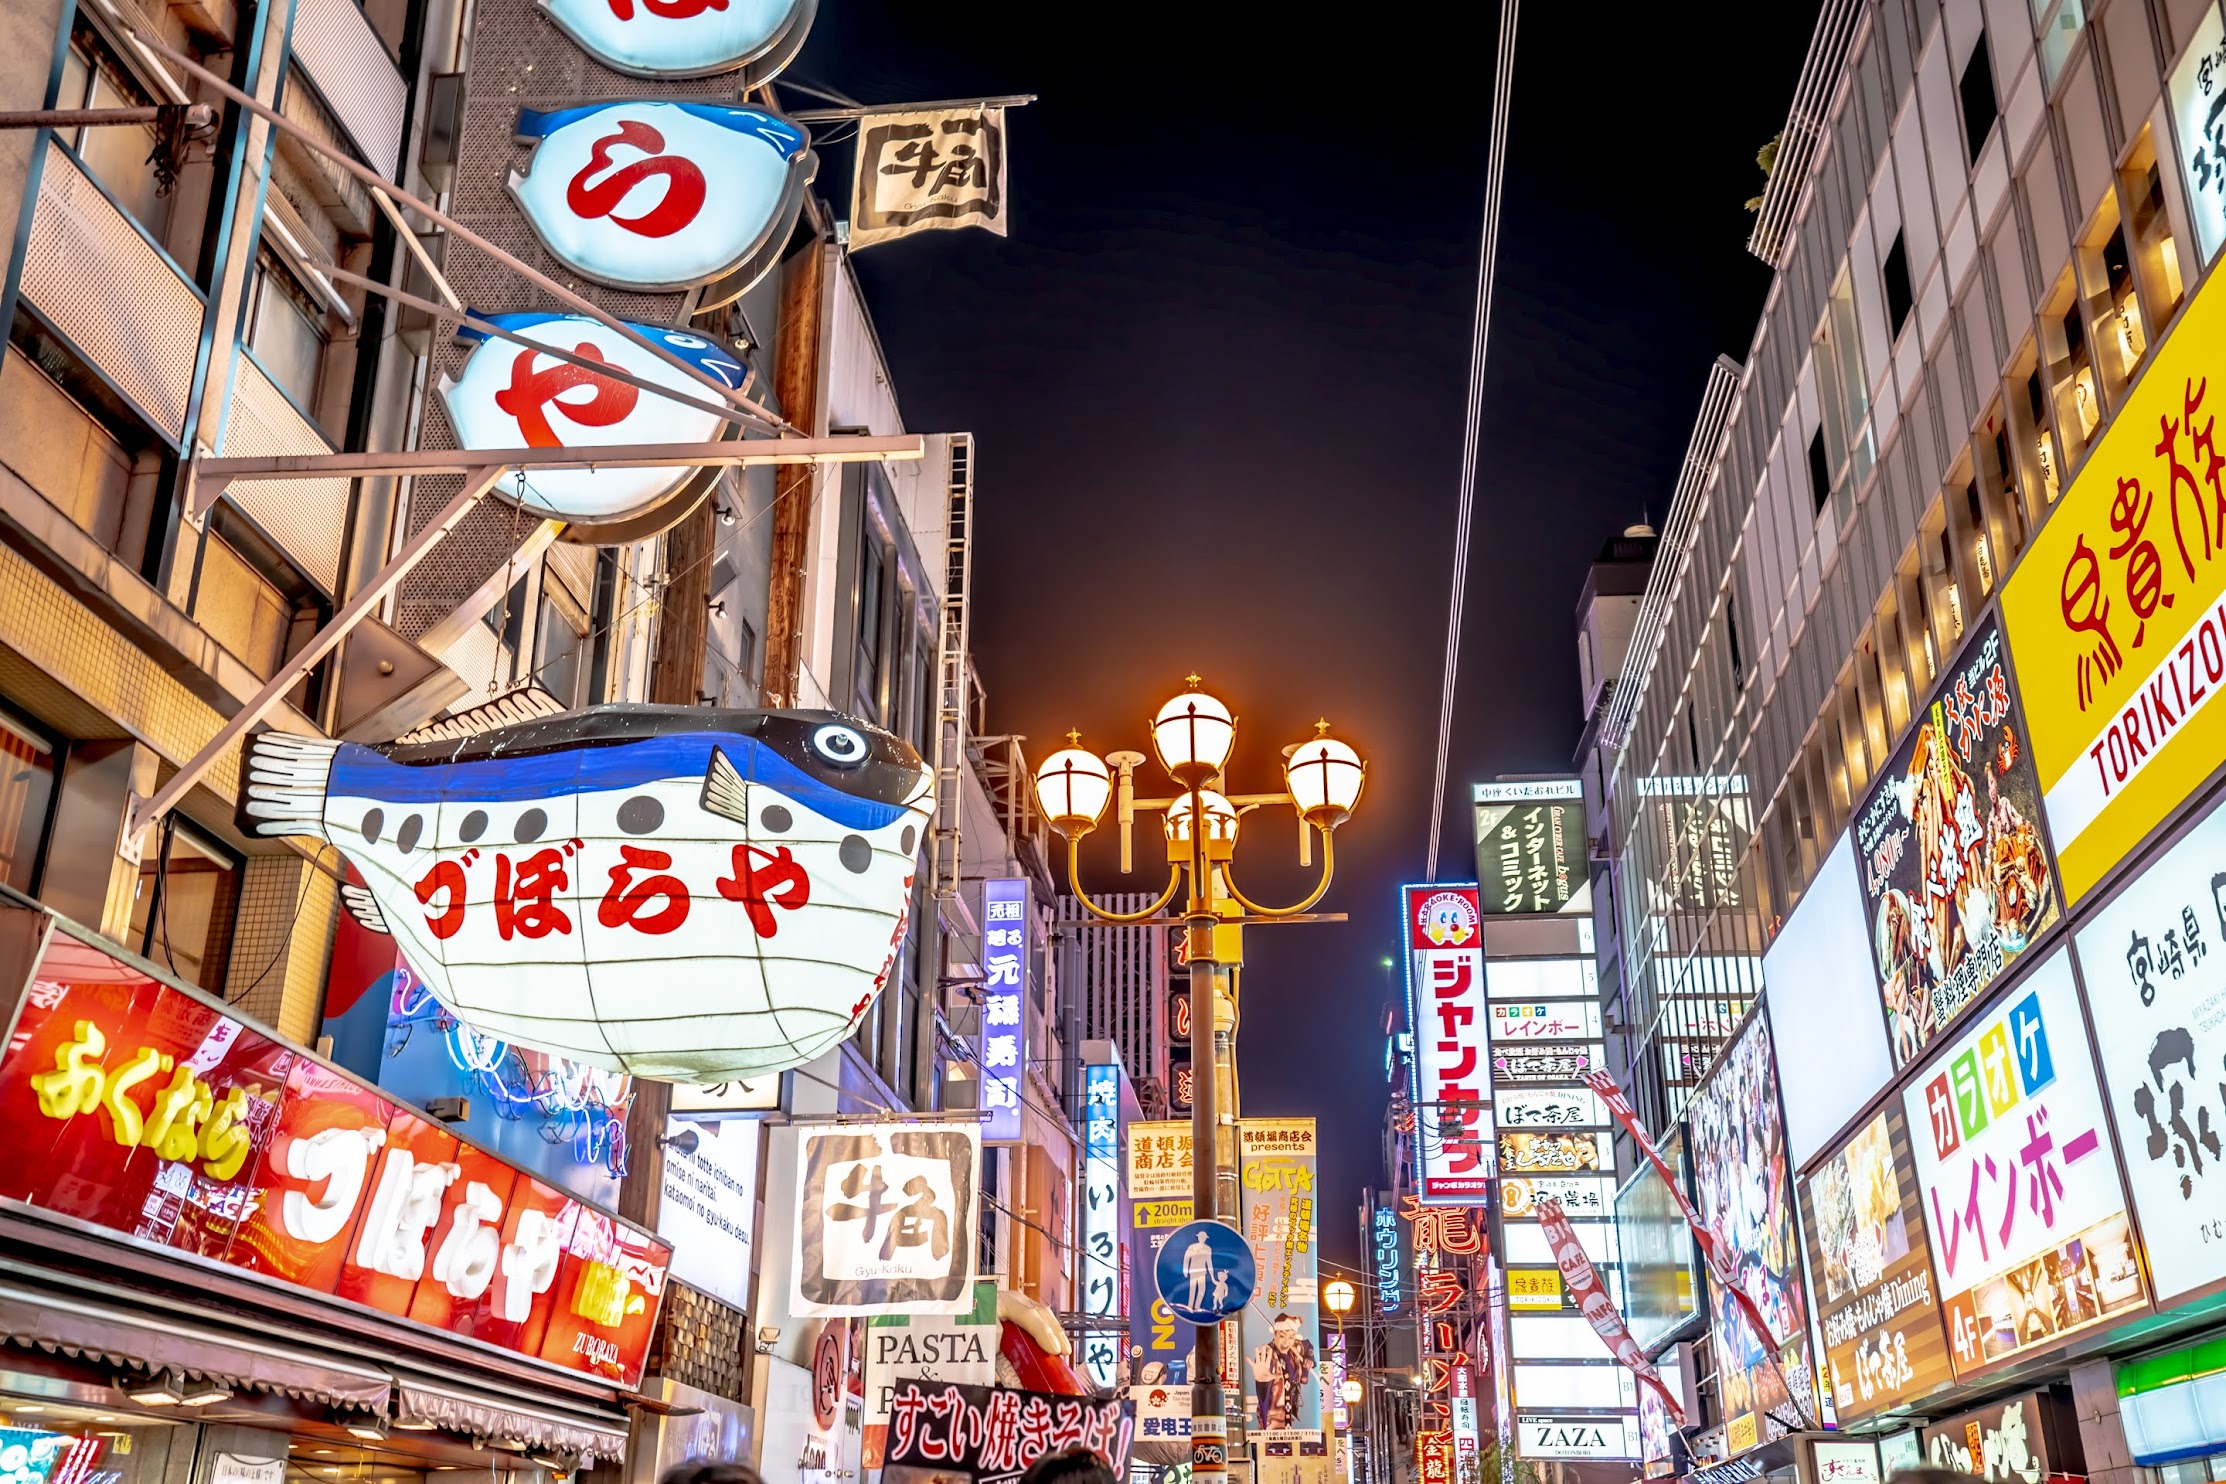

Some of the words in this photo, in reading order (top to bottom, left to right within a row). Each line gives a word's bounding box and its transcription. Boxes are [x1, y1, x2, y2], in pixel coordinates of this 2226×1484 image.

[880, 140, 987, 196] 牛角
[2089, 602, 2226, 797] TORIKIZO
[1482, 786, 1575, 798] 中座くいだおれビル
[1480, 810, 1497, 827] 2F
[1523, 807, 1550, 911] インターネット
[415, 838, 810, 941] づぼらや
[990, 903, 1020, 918] 元祖
[2127, 905, 2207, 1007] 宮崎県
[1496, 1006, 1546, 1018] カラオケ
[1505, 1019, 1579, 1036] レインボー
[1433, 956, 1482, 1173] ジャンカラ
[1511, 1057, 1574, 1073] ぼて茶屋
[1931, 1008, 2041, 1154] カラオケ
[1087, 1079, 1117, 1143] 焼肉
[1506, 1104, 1583, 1124] ぼて茶屋
[1134, 1135, 1192, 1153] 道頓堀
[1243, 1131, 1312, 1142] 道頓堀商店会
[1251, 1142, 1305, 1152] presents
[666, 1159, 686, 1181] omise
[687, 1172, 695, 1184] ni
[1135, 1152, 1192, 1170] 商店会
[697, 1152, 712, 1176] totte
[714, 1163, 735, 1190] ichiban
[735, 1182, 744, 1197] no
[1431, 1181, 1487, 1189] ジャンボカラオケ
[1931, 1104, 2099, 1279] レインボー
[664, 1178, 696, 1210] kataomoi
[696, 1203, 705, 1217] no
[735, 1223, 750, 1245] desu.
[826, 1163, 949, 1261] 牛角
[1153, 1217, 1176, 1225] straight
[1154, 1204, 1192, 1217] 200m
[283, 1125, 562, 1324] づぼらや
[2200, 1218, 2226, 1244] ひむ
[855, 1265, 913, 1277] Gyu-Kaku
[1560, 1252, 1586, 1272] CAFE
[1088, 1184, 1115, 1381] いろりや
[1515, 1277, 1554, 1293] 鳥貴族
[1891, 1269, 1931, 1312] Dining
[1586, 1301, 1612, 1324] INFO
[1953, 1306, 1976, 1362] 4F
[573, 1332, 619, 1363] ZUBORAYA
[876, 1333, 988, 1364] PASTA
[1622, 1351, 1643, 1366] LIV
[1855, 1329, 1913, 1401] ぼて茶屋
[1623, 1382, 1633, 1391] B1
[891, 1384, 1133, 1482] すごい焼きそば!
[1537, 1427, 1606, 1447] ZAZA
[1628, 1431, 1638, 1441] B1
